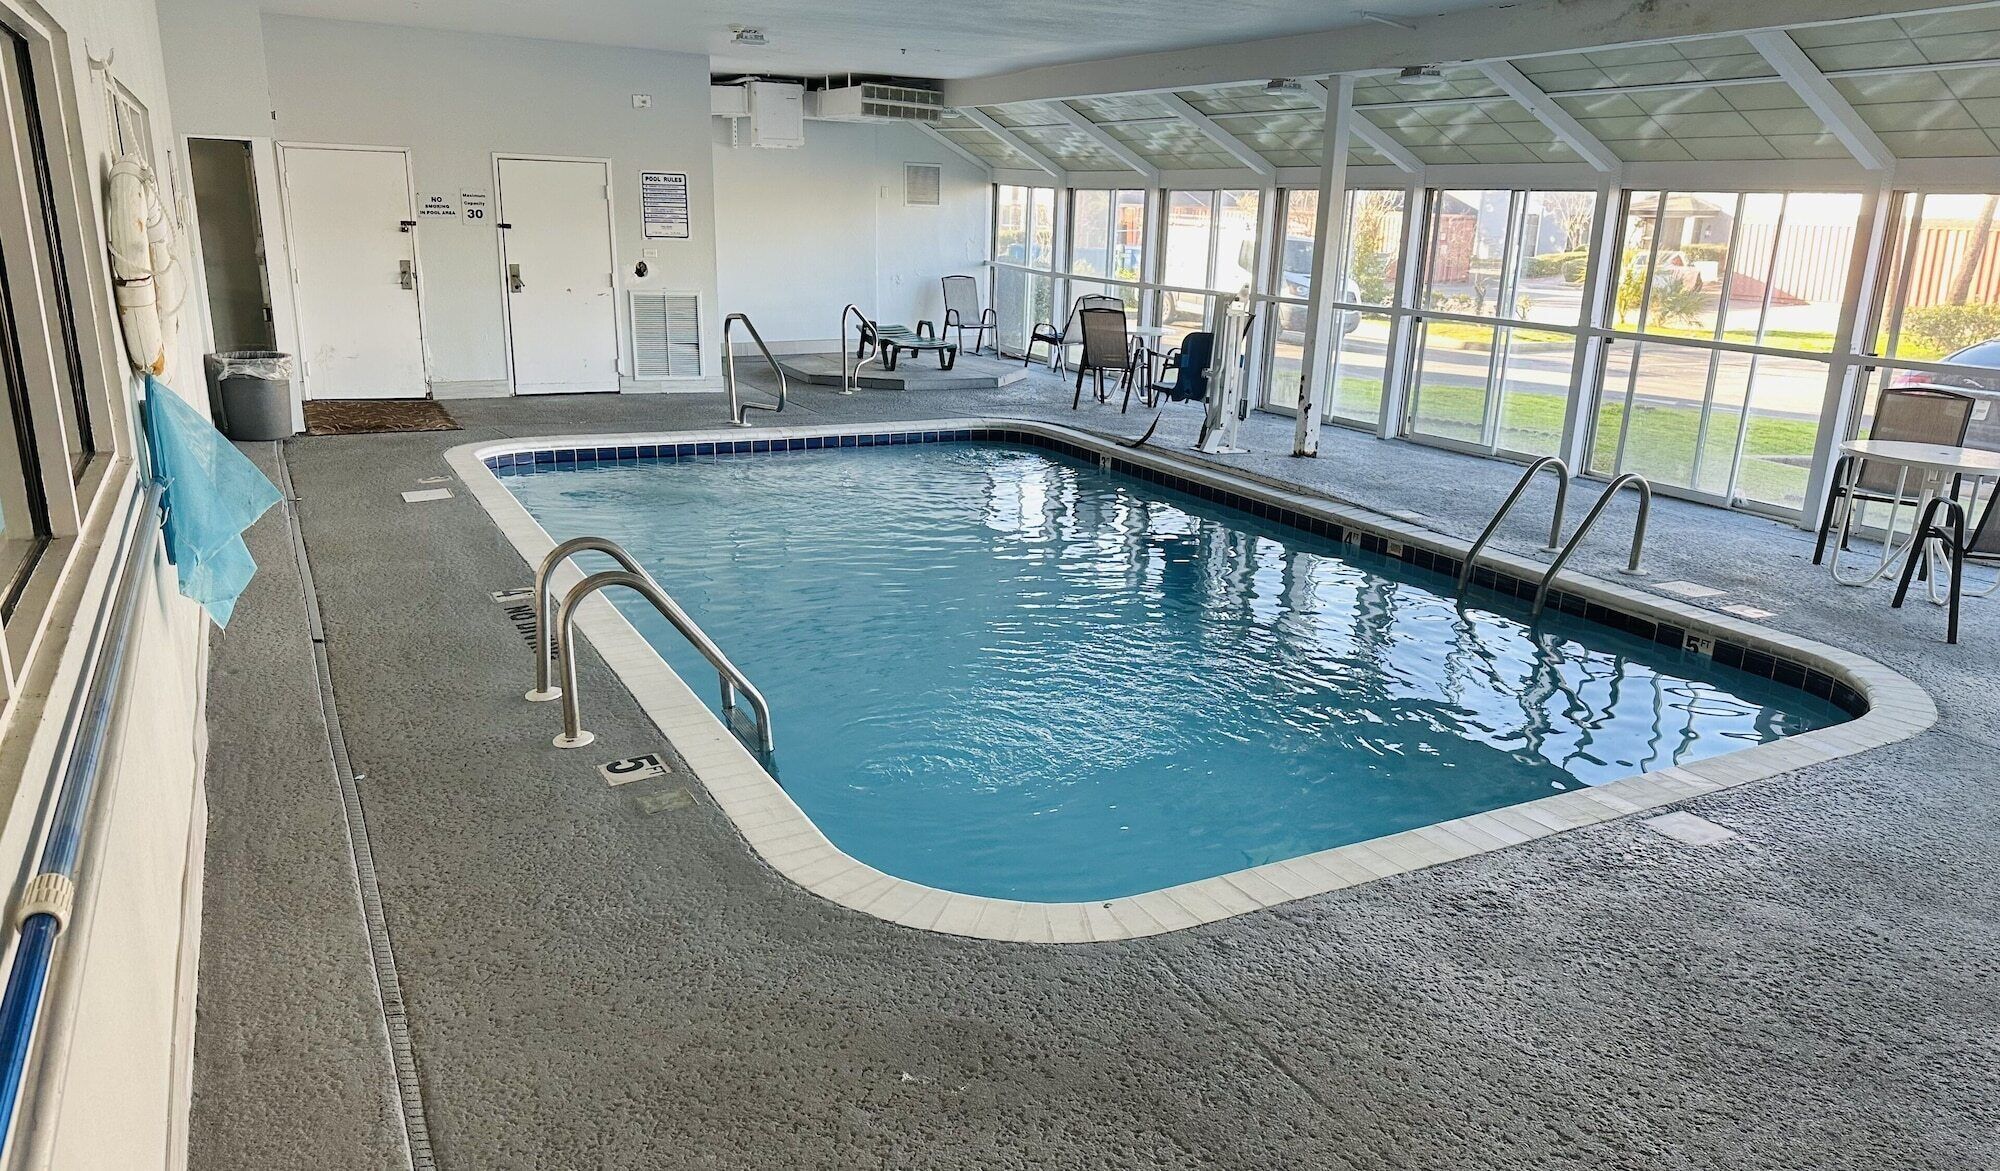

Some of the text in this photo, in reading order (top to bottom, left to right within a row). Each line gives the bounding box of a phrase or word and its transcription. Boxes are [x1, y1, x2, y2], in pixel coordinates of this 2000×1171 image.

[467, 209, 483, 219] 30
[1344, 531, 1352, 544] 4
[504, 605, 536, 620] NO
[1686, 634, 1711, 653] 5 FT
[606, 754, 667, 775] 5 FT
